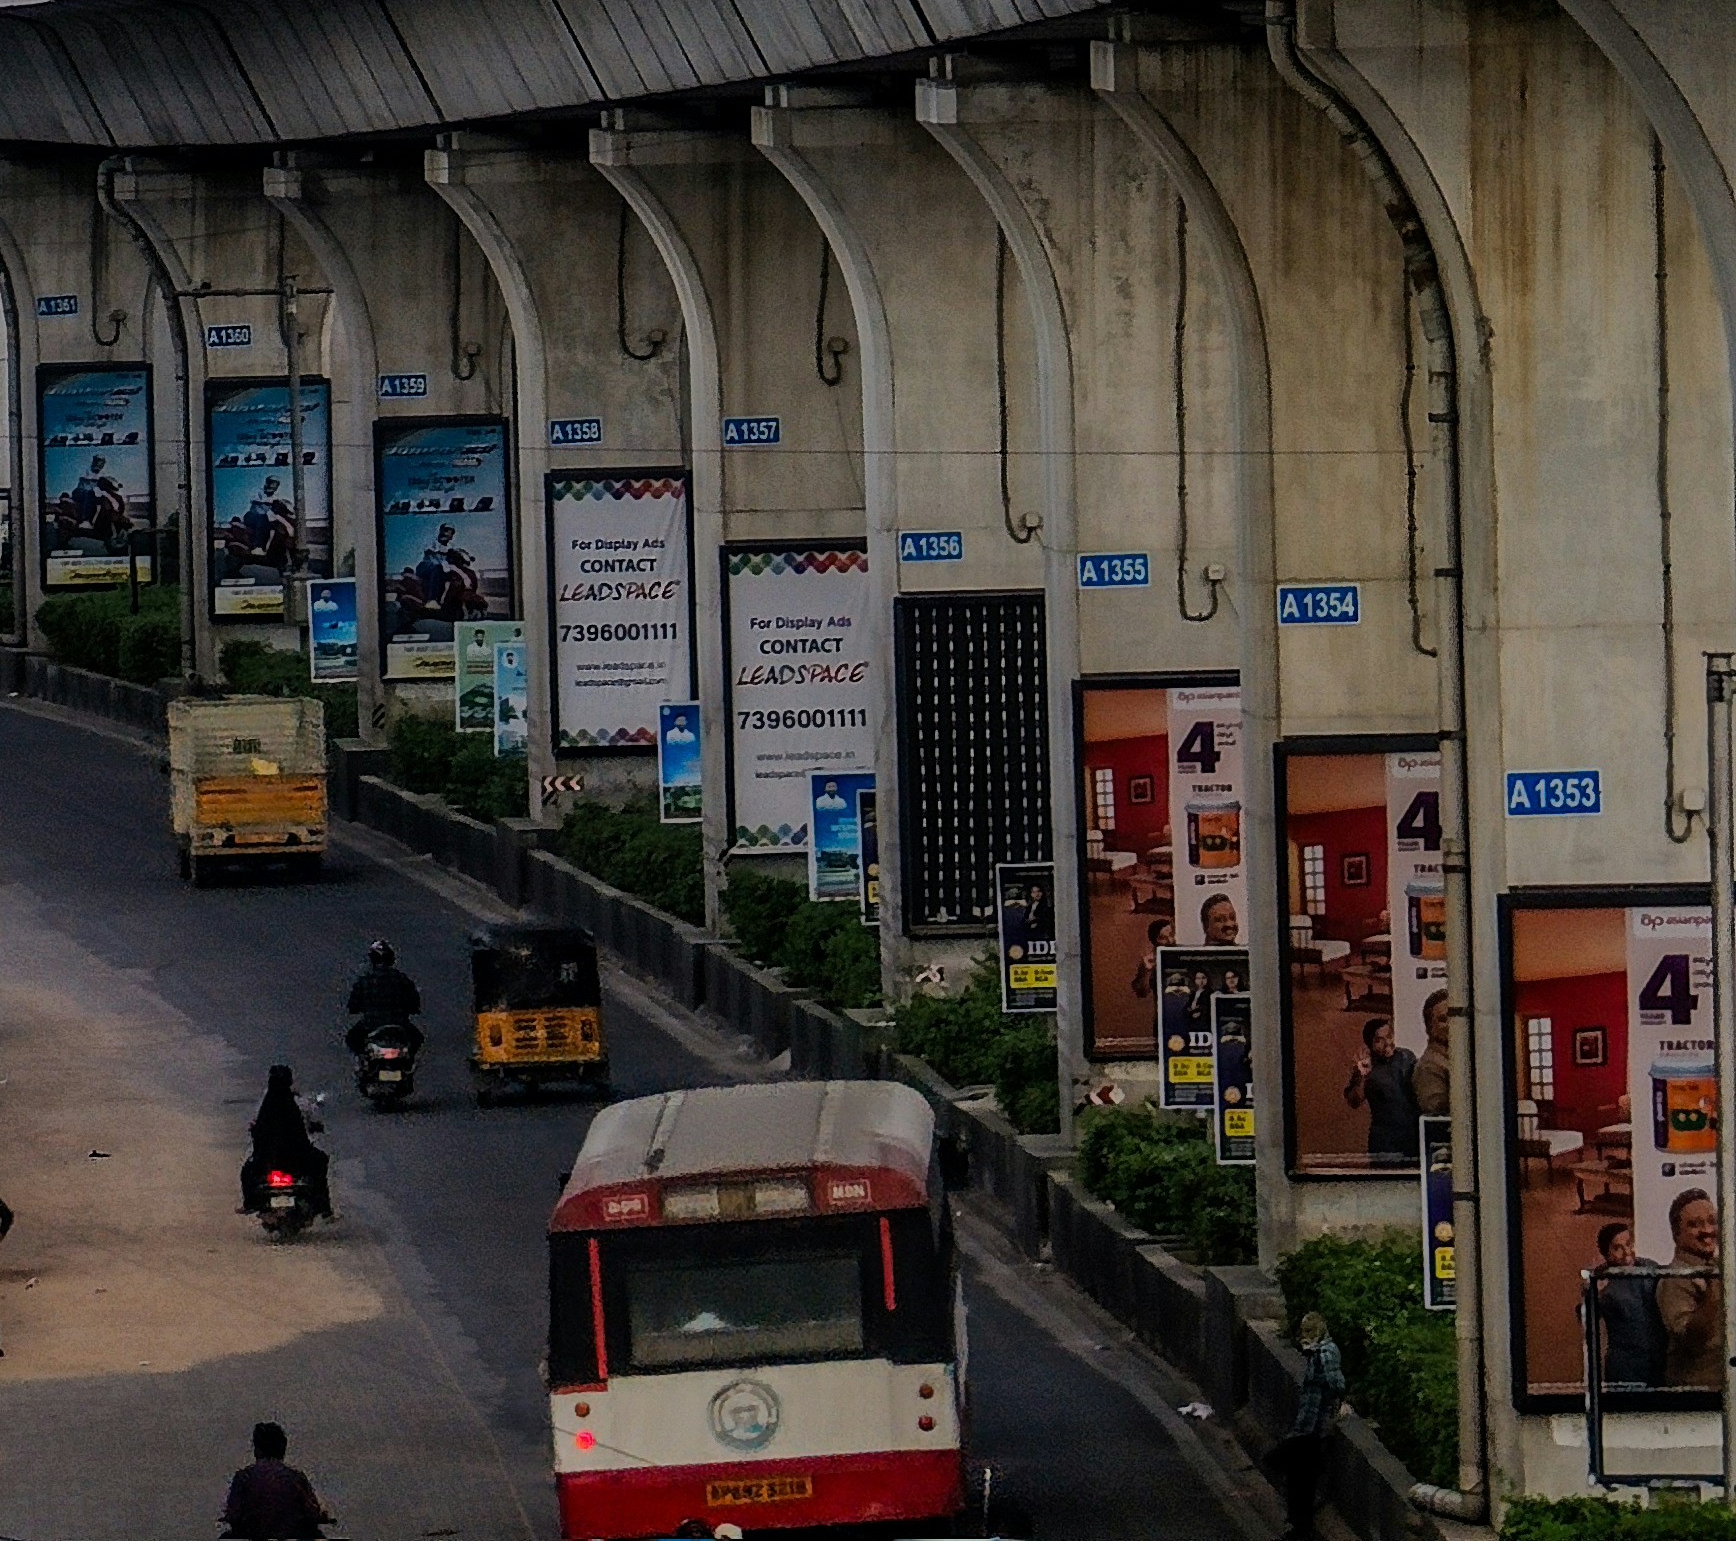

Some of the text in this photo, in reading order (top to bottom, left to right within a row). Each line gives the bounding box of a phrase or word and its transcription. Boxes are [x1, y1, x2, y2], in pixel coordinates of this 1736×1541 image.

[571, 537, 665, 552] For Display Ads
[580, 558, 657, 573] CONTACT
[559, 580, 678, 602] LEADSPACE
[559, 622, 677, 643] 7396001111
[750, 616, 852, 630] For Display Ads
[759, 637, 844, 655] CONTACT
[736, 662, 867, 686] LEADSPACE
[737, 708, 867, 730] 7396001111
[1177, 720, 1221, 774] 4
[1396, 791, 1442, 851] 4
[1639, 954, 1699, 1025] 4
[1659, 1039, 1714, 1051] TRACTOR
